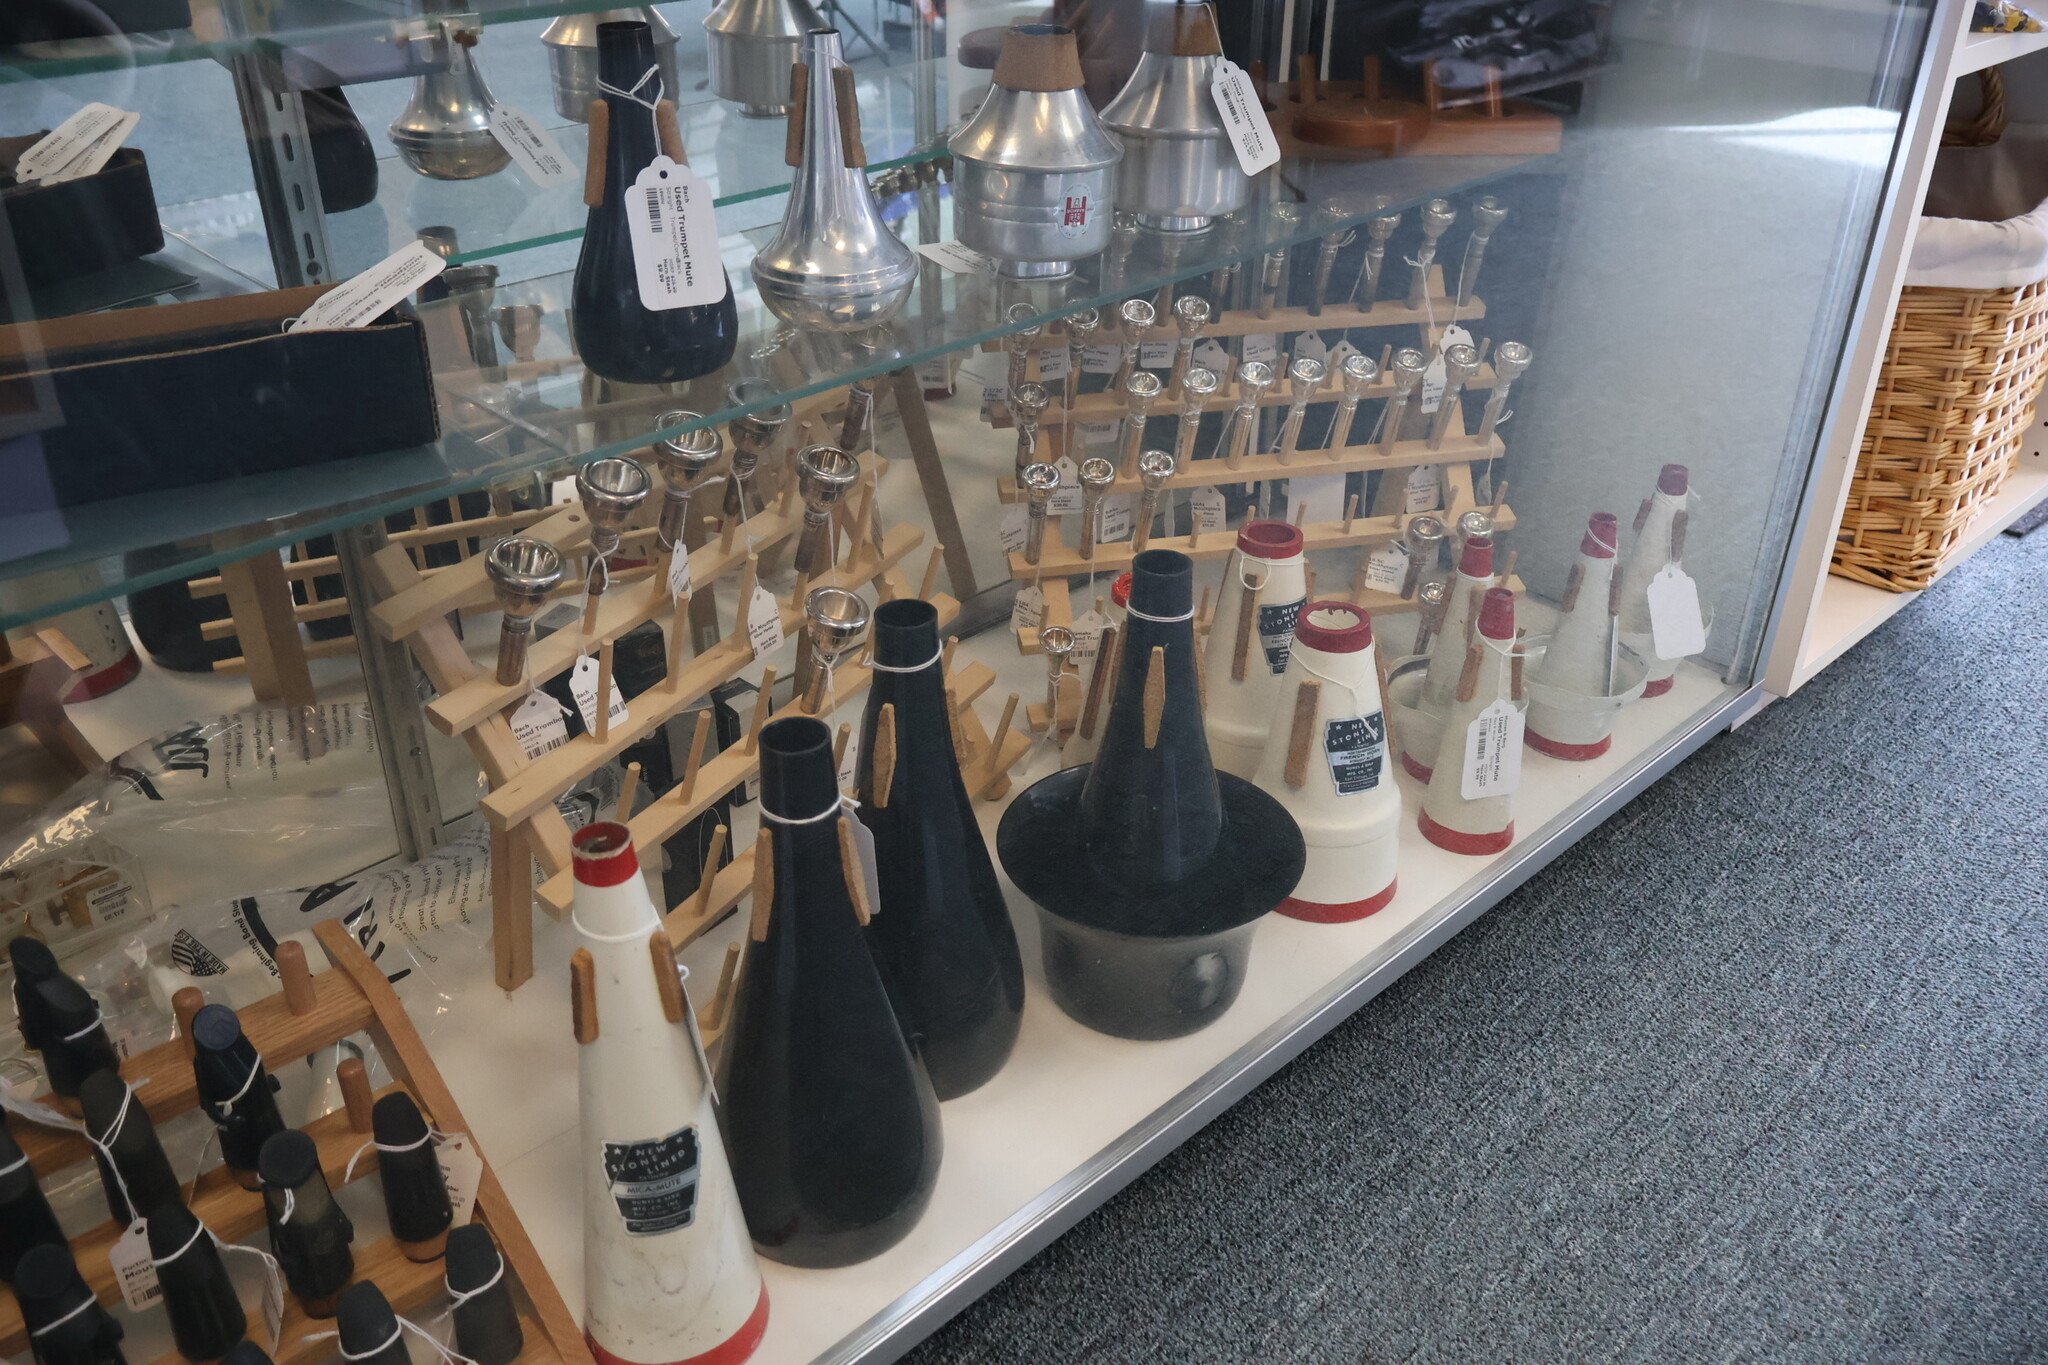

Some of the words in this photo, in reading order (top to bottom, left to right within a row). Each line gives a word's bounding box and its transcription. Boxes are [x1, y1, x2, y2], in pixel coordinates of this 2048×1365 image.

[674, 187, 684, 212] Used
[678, 216, 690, 259] Trumpet
[684, 262, 693, 287] Mute
[1281, 605, 1299, 614] NEW
[1264, 613, 1295, 629] STONE
[576, 689, 590, 700] Bach
[579, 695, 595, 707] Used
[514, 724, 530, 734] Bach
[516, 728, 535, 741] Used
[1332, 729, 1364, 745] STONE
[235, 918, 251, 940] Band
[188, 940, 202, 954] THE
[203, 949, 212, 959] IN
[210, 957, 228, 974] MADE
[249, 938, 280, 977] Beginning
[636, 1144, 667, 1156] NEW
[611, 1154, 658, 1173] STONE
[647, 1149, 685, 1174] LINED
